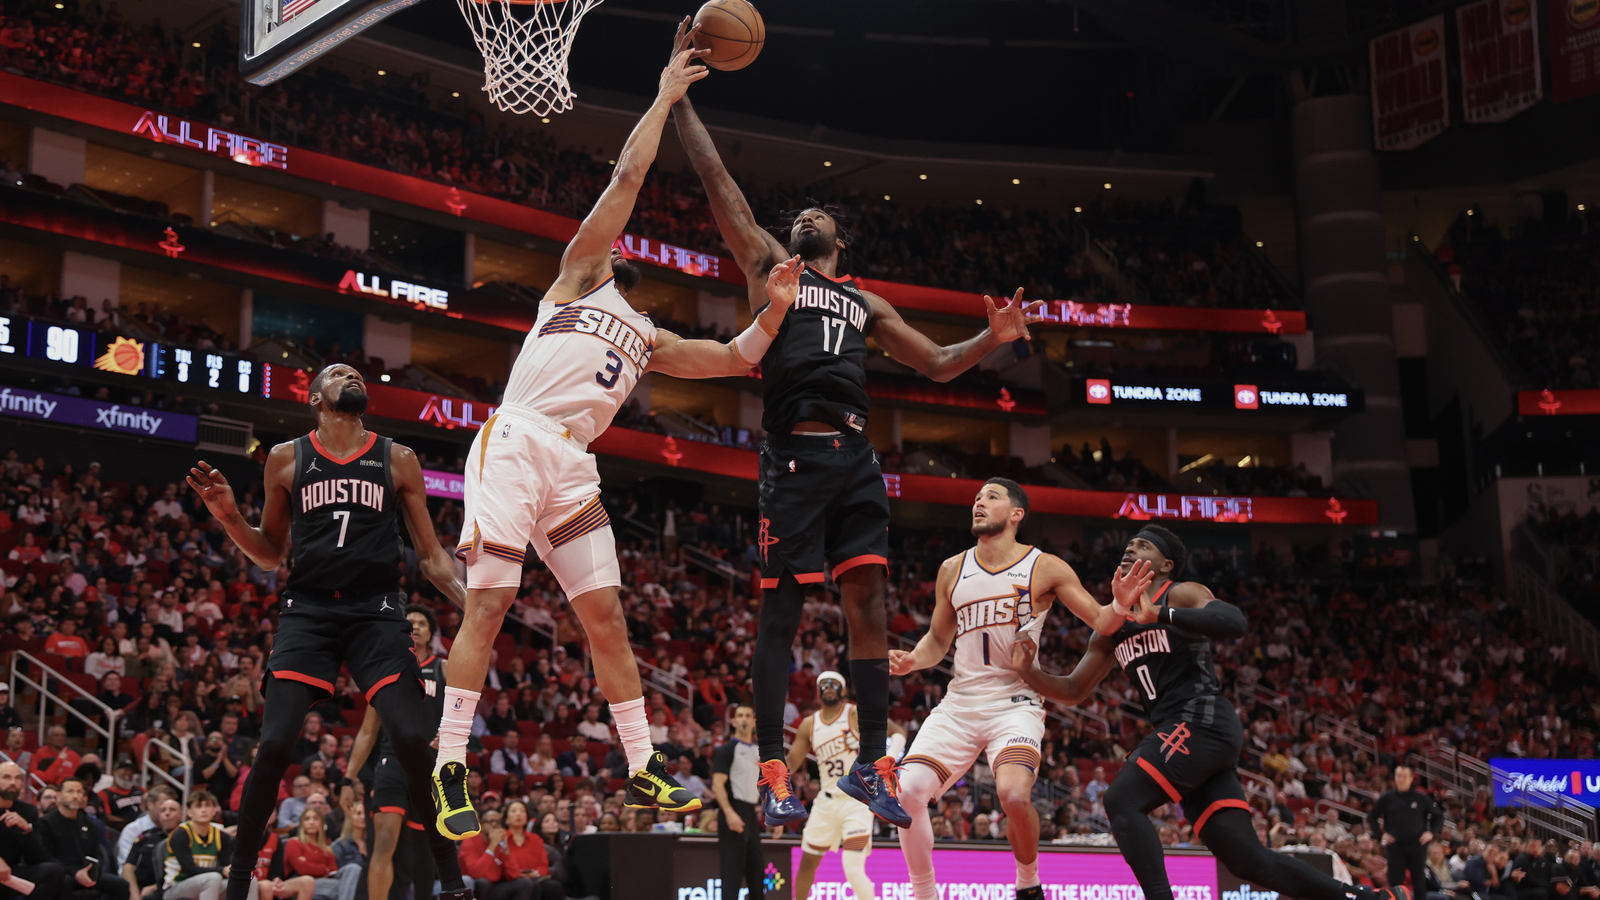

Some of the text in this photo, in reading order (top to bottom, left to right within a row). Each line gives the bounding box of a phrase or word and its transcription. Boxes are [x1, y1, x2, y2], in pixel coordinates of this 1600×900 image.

[296, 27, 355, 62] veraclinic.net
[357, 13, 380, 26] Hair
[132, 110, 203, 149] ALL
[338, 269, 449, 310] ALL FIRE
[794, 285, 868, 333] HOUSTON
[46, 326, 79, 364] 90
[821, 315, 847, 356] 17
[177, 363, 188, 383] 3
[208, 369, 219, 388] 2
[595, 350, 623, 391] 3
[1112, 385, 1202, 402] TUNDRA ZONE
[1259, 390, 1348, 407] TUNDRA ZONE
[96, 405, 162, 435] xfinity
[301, 478, 385, 514] HOUSTON
[1118, 493, 1179, 518] ALL
[333, 510, 351, 548] 7
[957, 597, 1015, 636] SUNS
[982, 632, 991, 666] 1
[1114, 628, 1172, 672] HOUSTON
[1136, 664, 1157, 700] 0
[825, 759, 844, 778] 23
[1502, 772, 1568, 793] Michelob
[949, 883, 1015, 900] PROVIDE
[1048, 884, 1078, 900] THE
